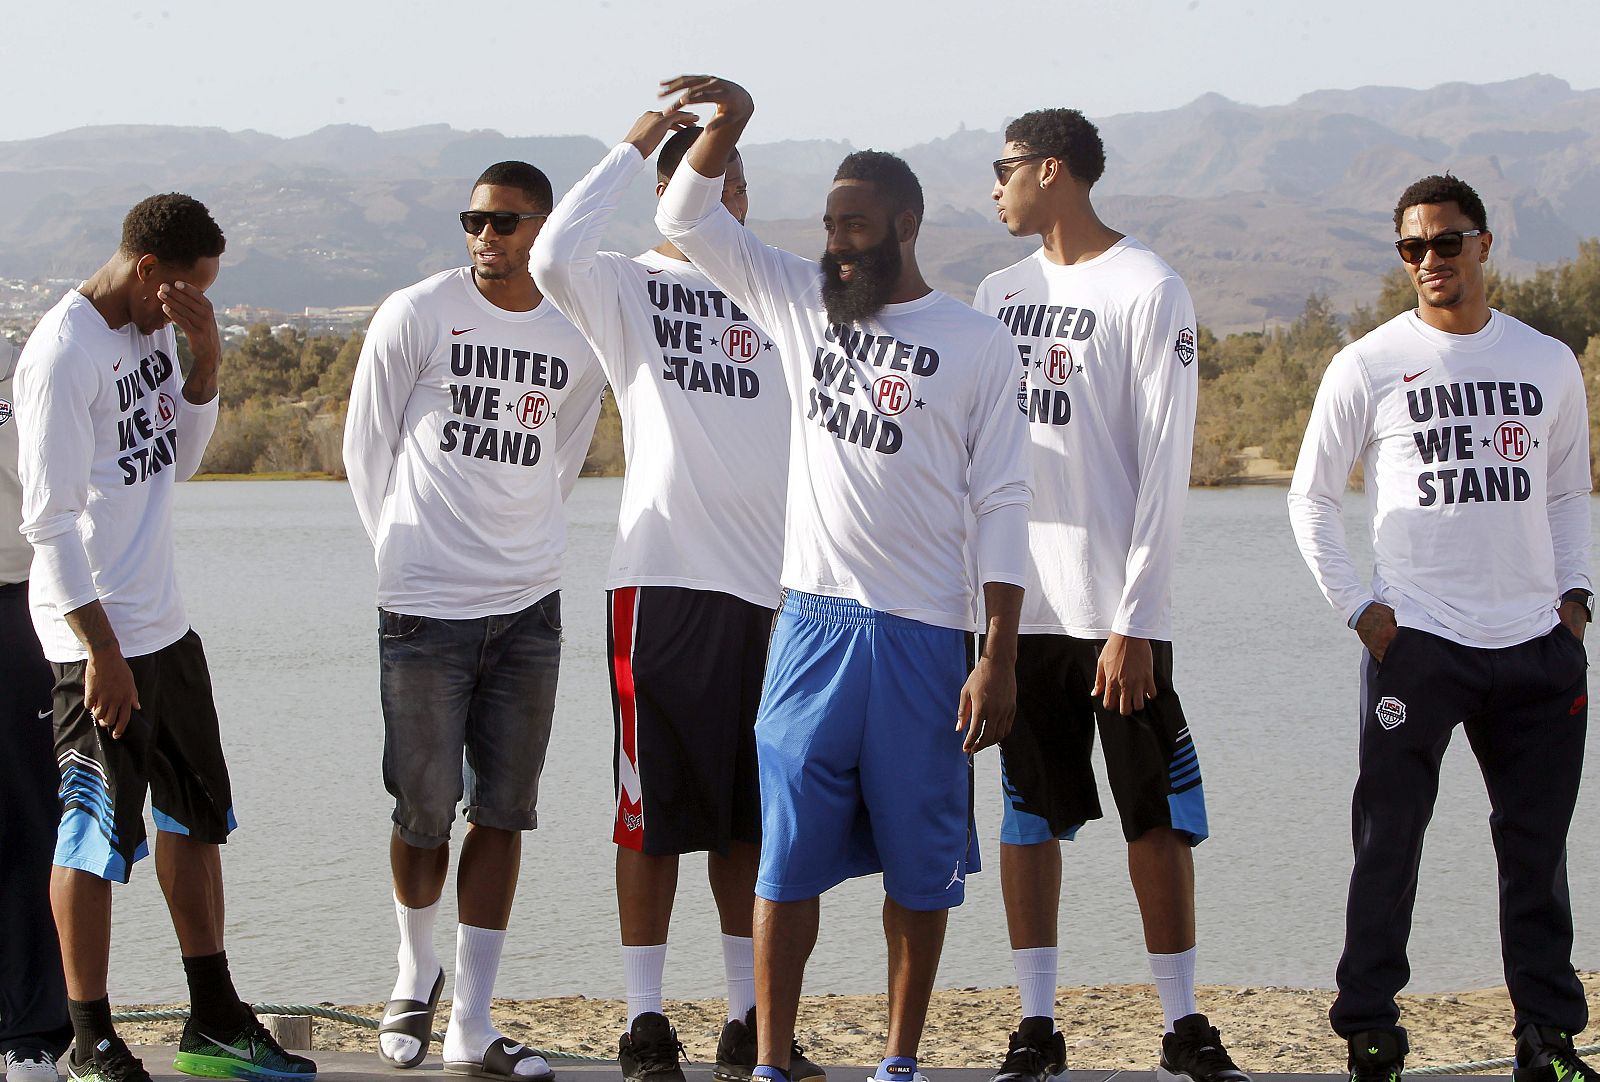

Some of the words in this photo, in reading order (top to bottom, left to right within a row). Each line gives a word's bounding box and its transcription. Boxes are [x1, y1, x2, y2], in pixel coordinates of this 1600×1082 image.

[647, 280, 749, 321] UNIT
[652, 315, 703, 354] WE
[728, 329, 753, 358] PG
[450, 343, 569, 390] UNITED
[812, 346, 857, 396] WE
[877, 379, 905, 412] PG
[1049, 349, 1067, 380] PG
[450, 384, 501, 421] WE
[521, 395, 545, 425] PG
[807, 386, 903, 455] STAND
[1406, 381, 1544, 423] UNITED
[440, 420, 541, 467] STAND
[1413, 425, 1474, 465] WE
[1501, 426, 1524, 456] PG
[1417, 466, 1531, 507] STAND
